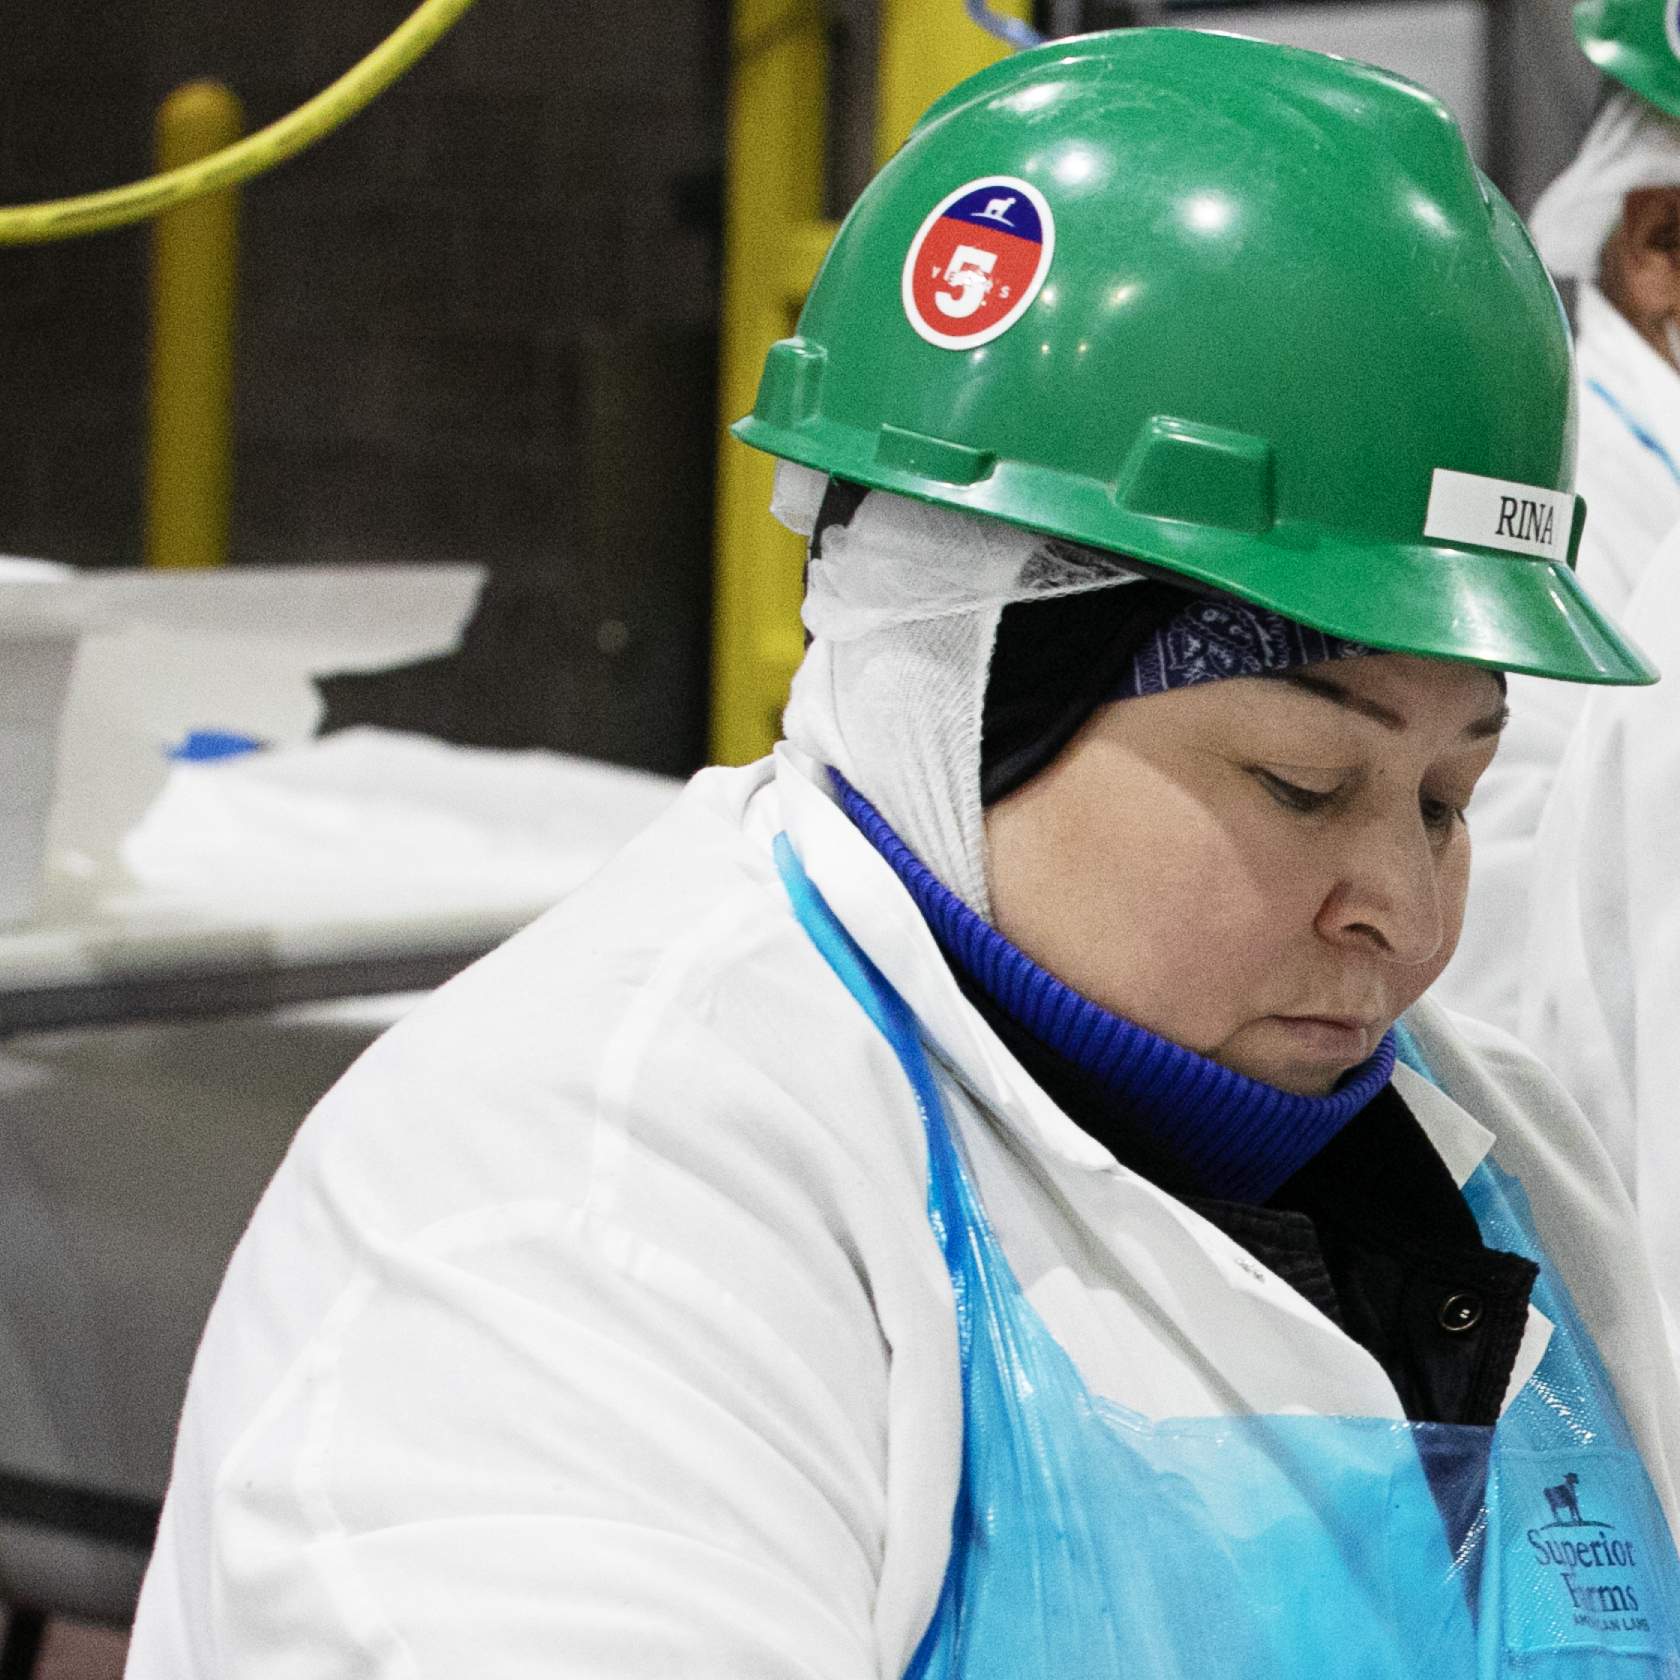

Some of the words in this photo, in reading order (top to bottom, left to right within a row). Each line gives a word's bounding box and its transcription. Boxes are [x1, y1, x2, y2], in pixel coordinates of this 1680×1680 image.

[934, 244, 998, 319] 5
[1495, 496, 1554, 545] RINA
[1527, 1529, 1636, 1569] Superior
[1560, 1571, 1639, 1613] Frms
